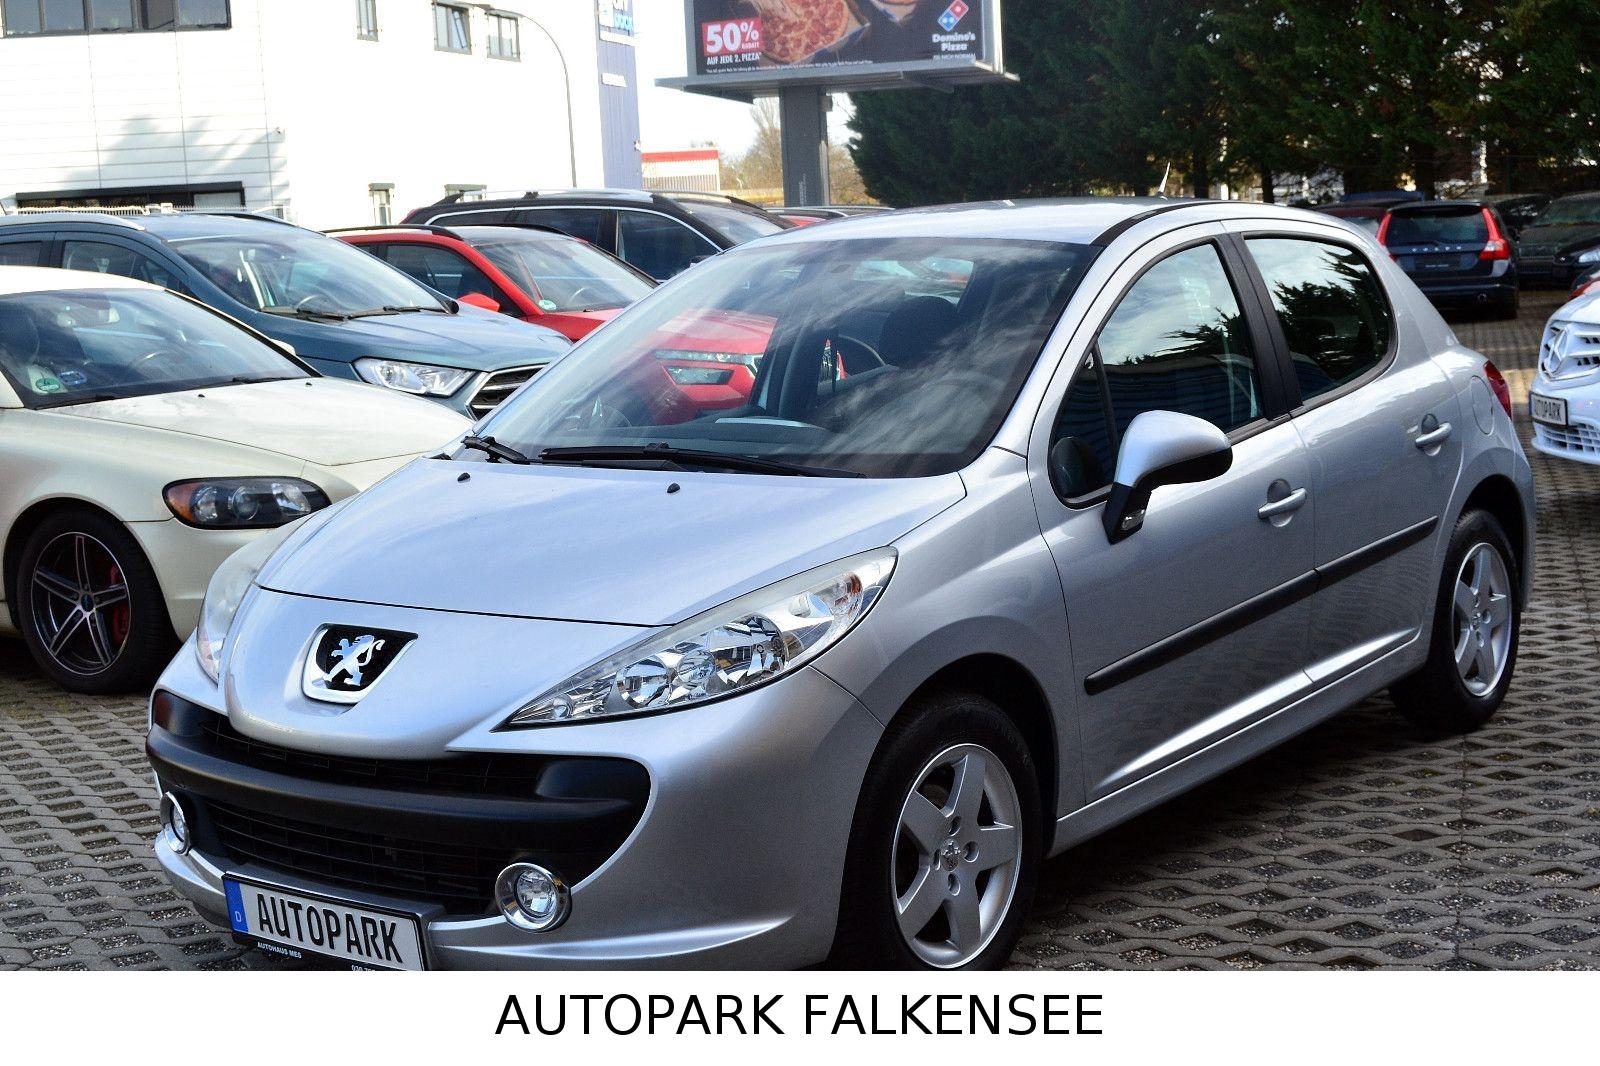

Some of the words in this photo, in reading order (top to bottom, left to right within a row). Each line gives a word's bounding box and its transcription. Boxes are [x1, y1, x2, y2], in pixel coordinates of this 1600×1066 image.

[706, 21, 759, 53] 50%
[932, 32, 976, 43] Domino's
[941, 42, 968, 52] Pizza
[707, 56, 719, 65] AUF
[720, 55, 734, 64] JEDE
[235, 911, 242, 923] D
[257, 893, 403, 963] AUTOPARK
[257, 941, 289, 955] AUTOHAUS
